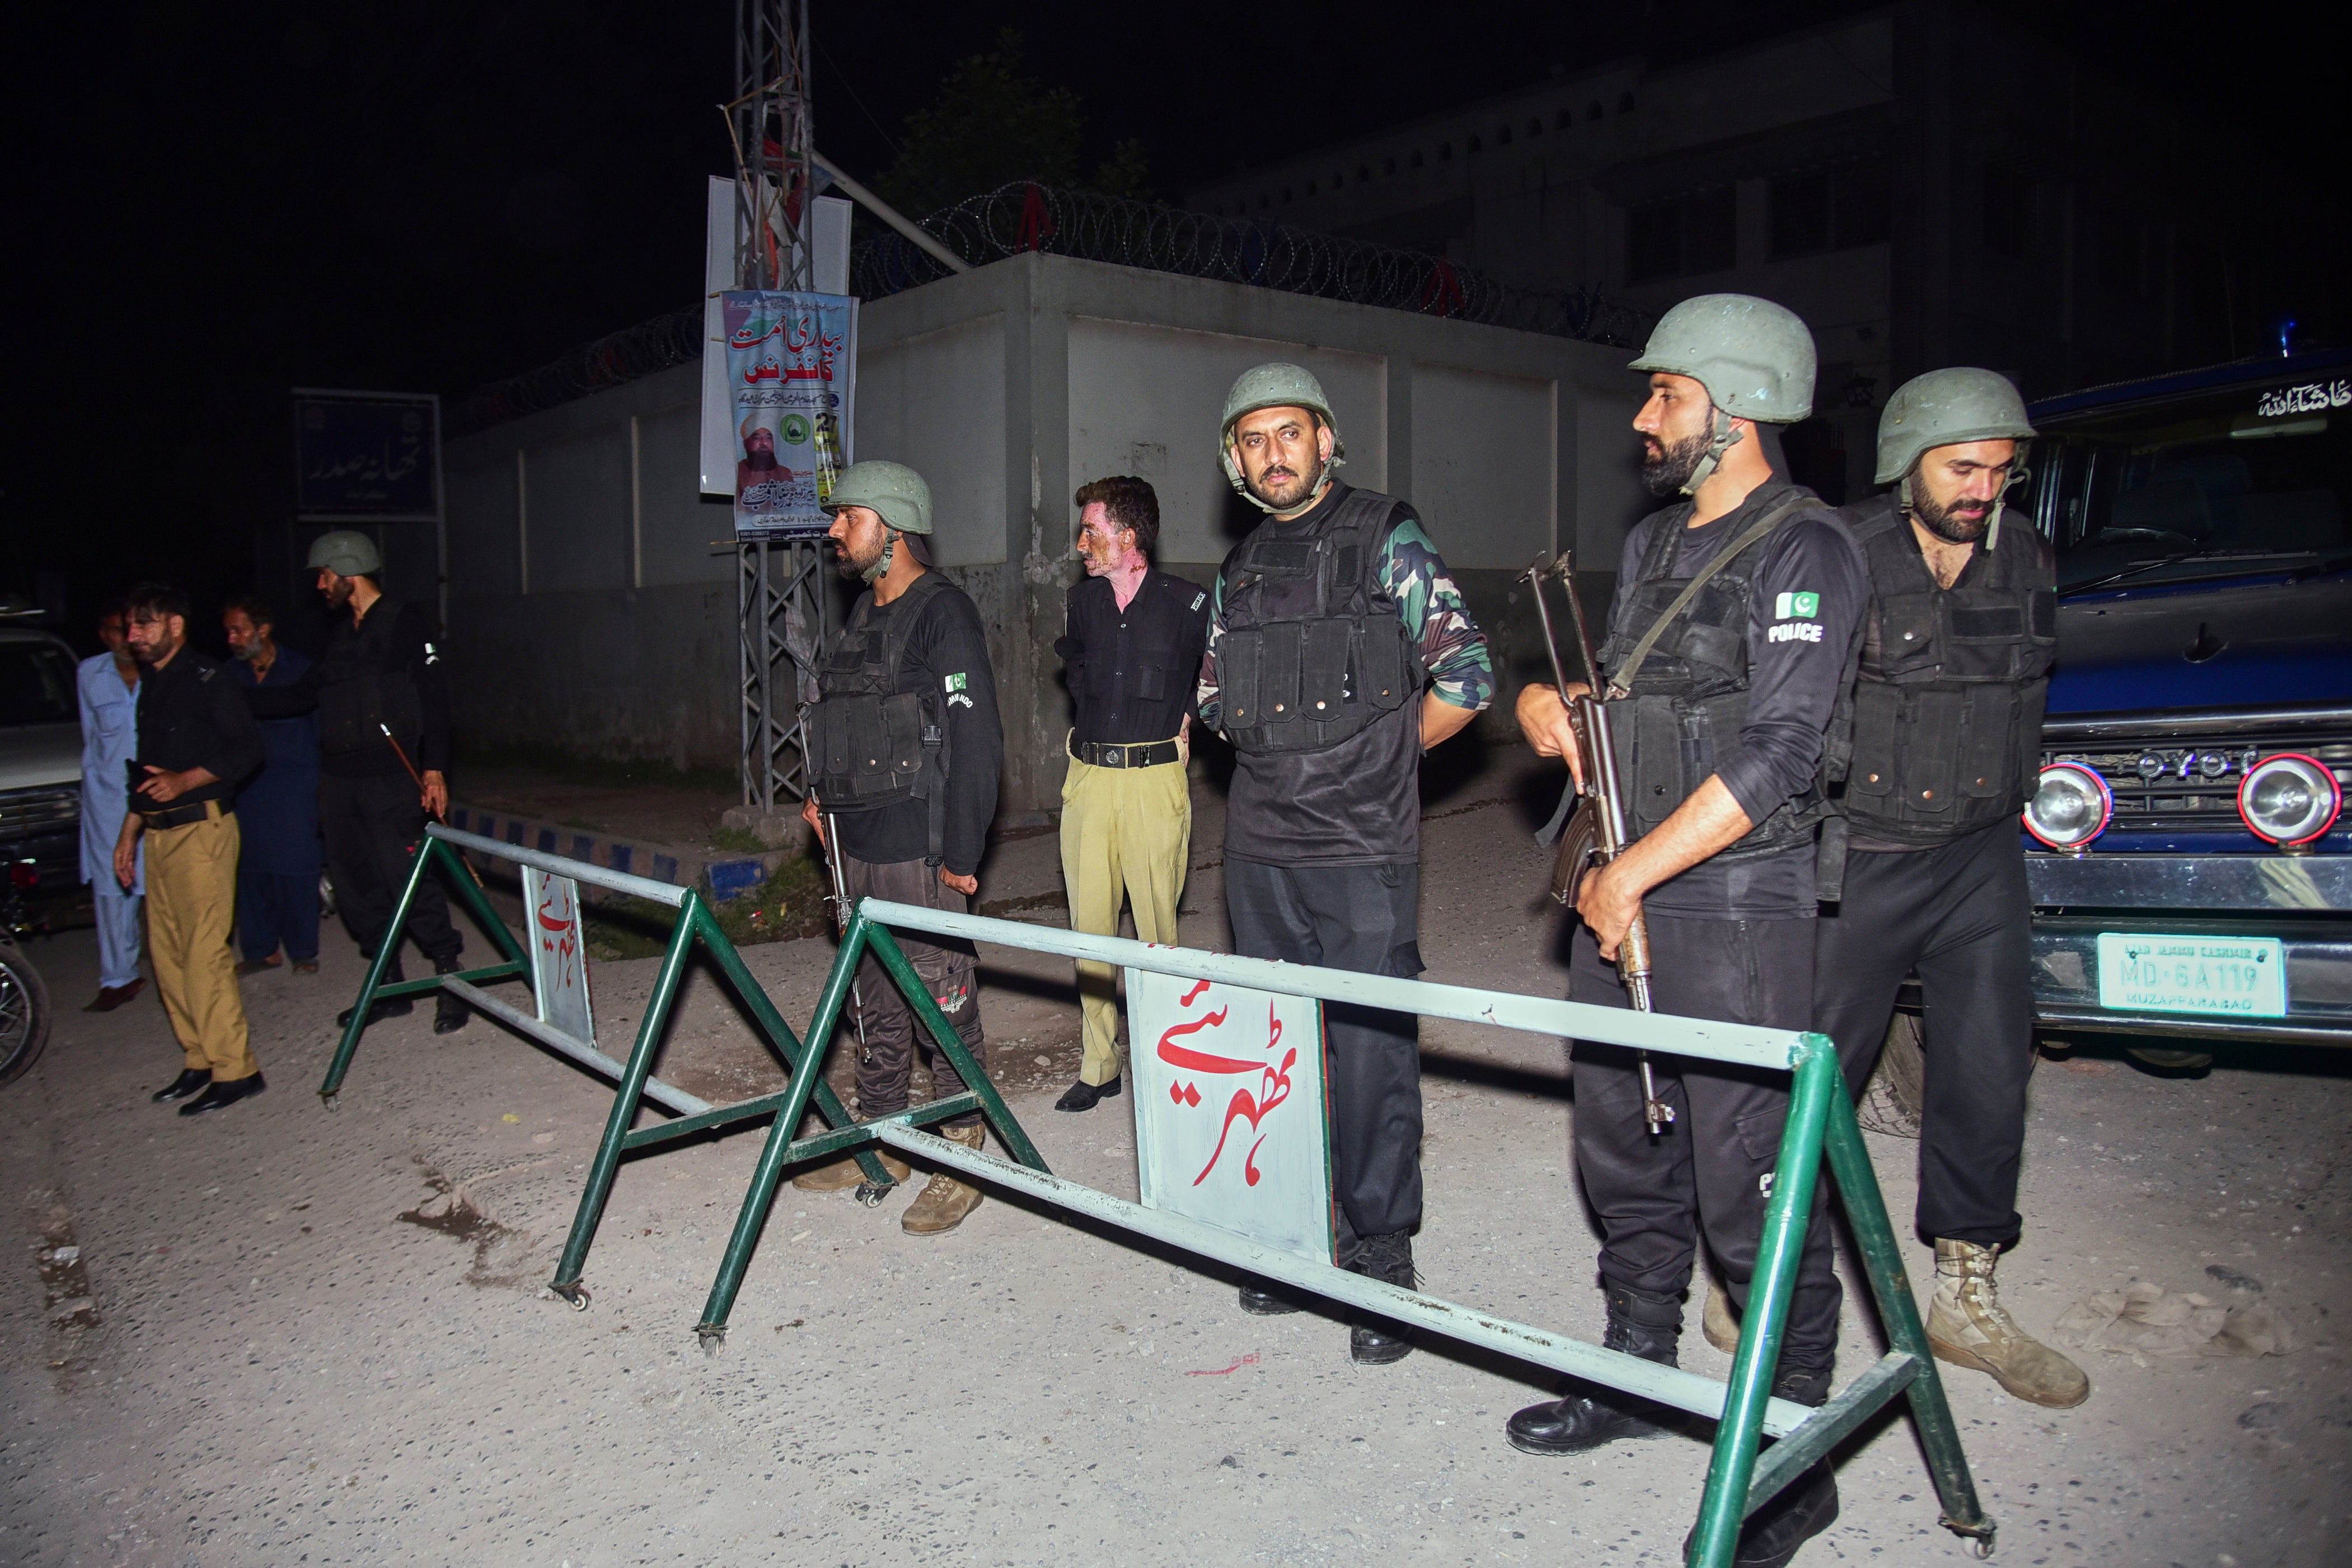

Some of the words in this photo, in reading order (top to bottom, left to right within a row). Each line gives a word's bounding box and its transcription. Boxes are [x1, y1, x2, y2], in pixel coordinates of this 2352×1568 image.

[744, 356, 834, 384] کانفرنس
[816, 412, 837, 433] 27
[1768, 622, 1823, 643] POLICE
[2125, 944, 2150, 955] AZAD
[2127, 993, 2253, 1011] MUZAFFARABAD
